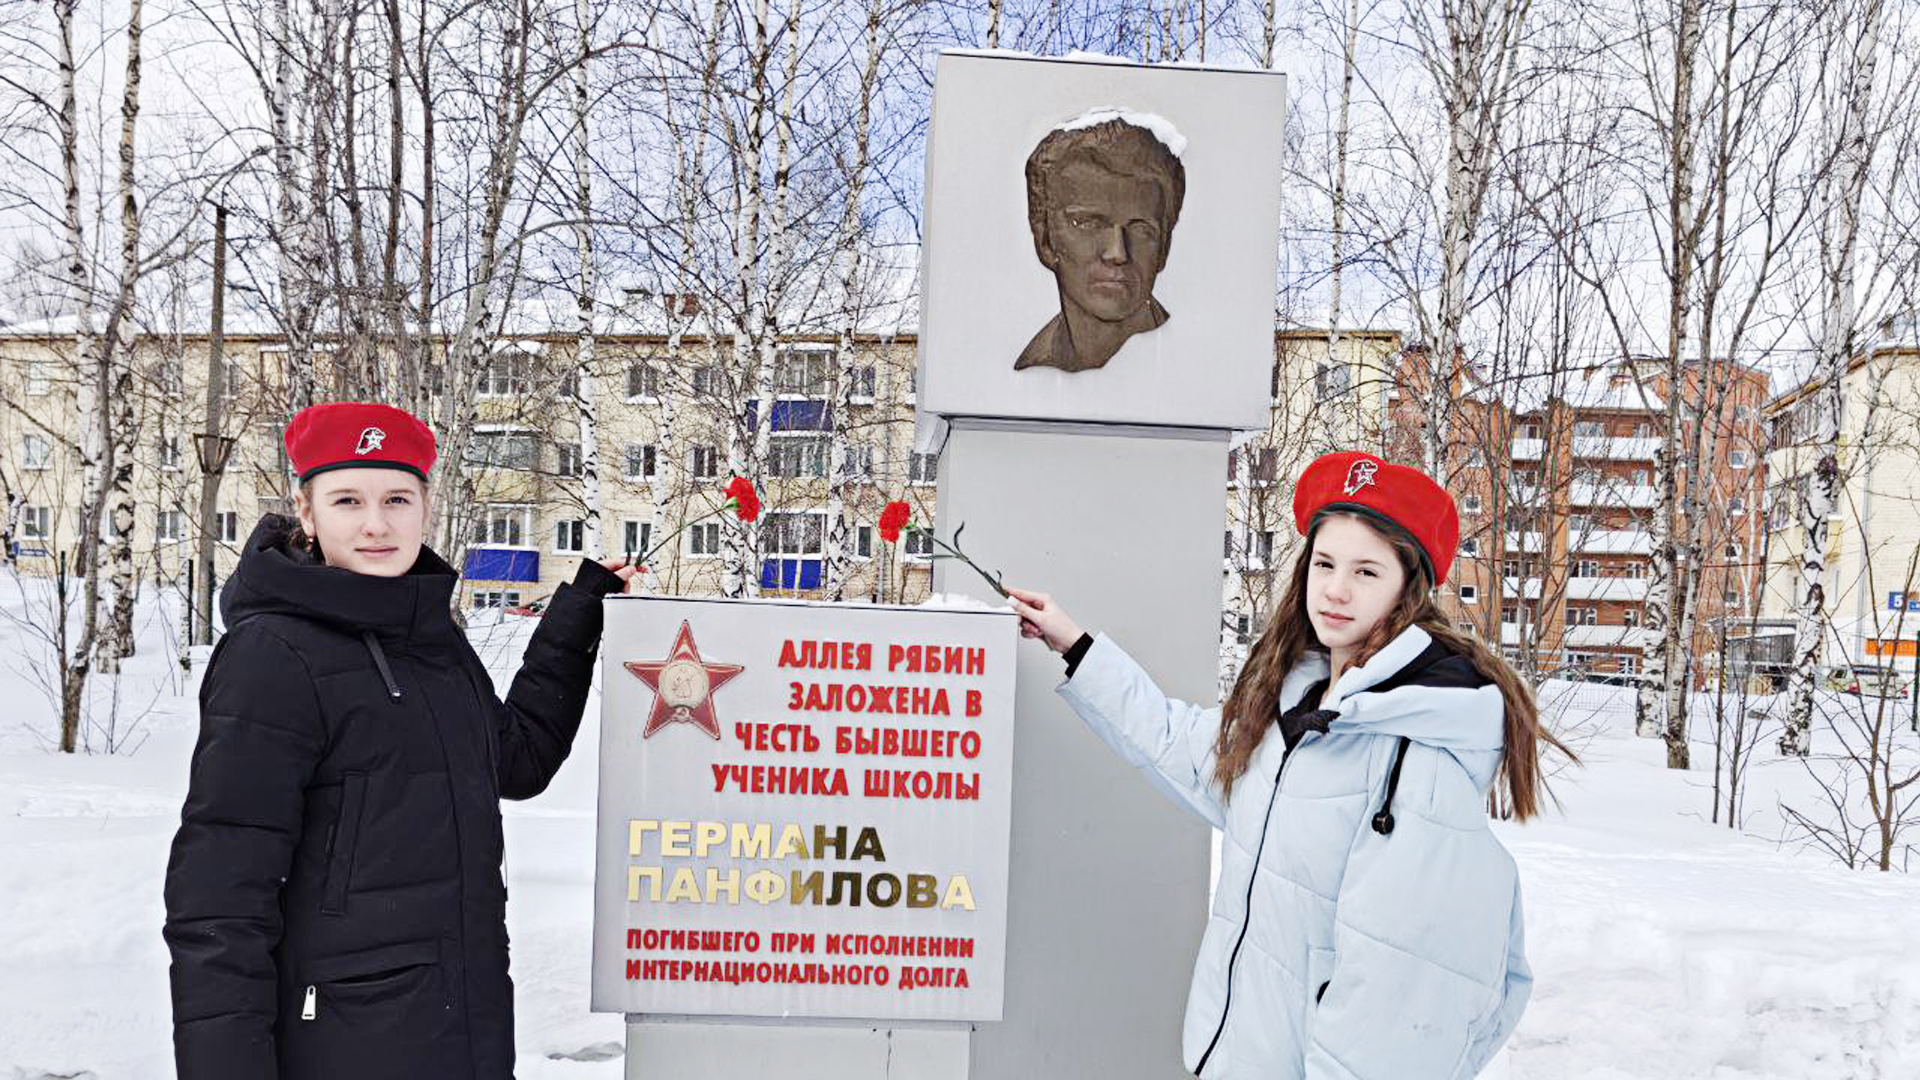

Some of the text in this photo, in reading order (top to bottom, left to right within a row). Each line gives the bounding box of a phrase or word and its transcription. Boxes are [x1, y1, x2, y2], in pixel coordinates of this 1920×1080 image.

[777, 639, 985, 675] АЛЛЕЯ РЯБИН
[788, 682, 982, 717] ЗАЛОЖЕНА В
[735, 722, 982, 759] ЧЕСТЬ БЫВШЕГО
[711, 764, 980, 800] УЧЕНИКА ШКОЛЫ
[627, 819, 886, 862] ГЕРМАНА
[627, 865, 976, 911] ПАНФИЛОВА
[627, 928, 974, 959] ПОГИБШЕГО ПРИ ИСПОЛНЕНИИ
[626, 959, 969, 990] ИНТЕРНАЦИОНАЛЬНОГО ДОЛГА
